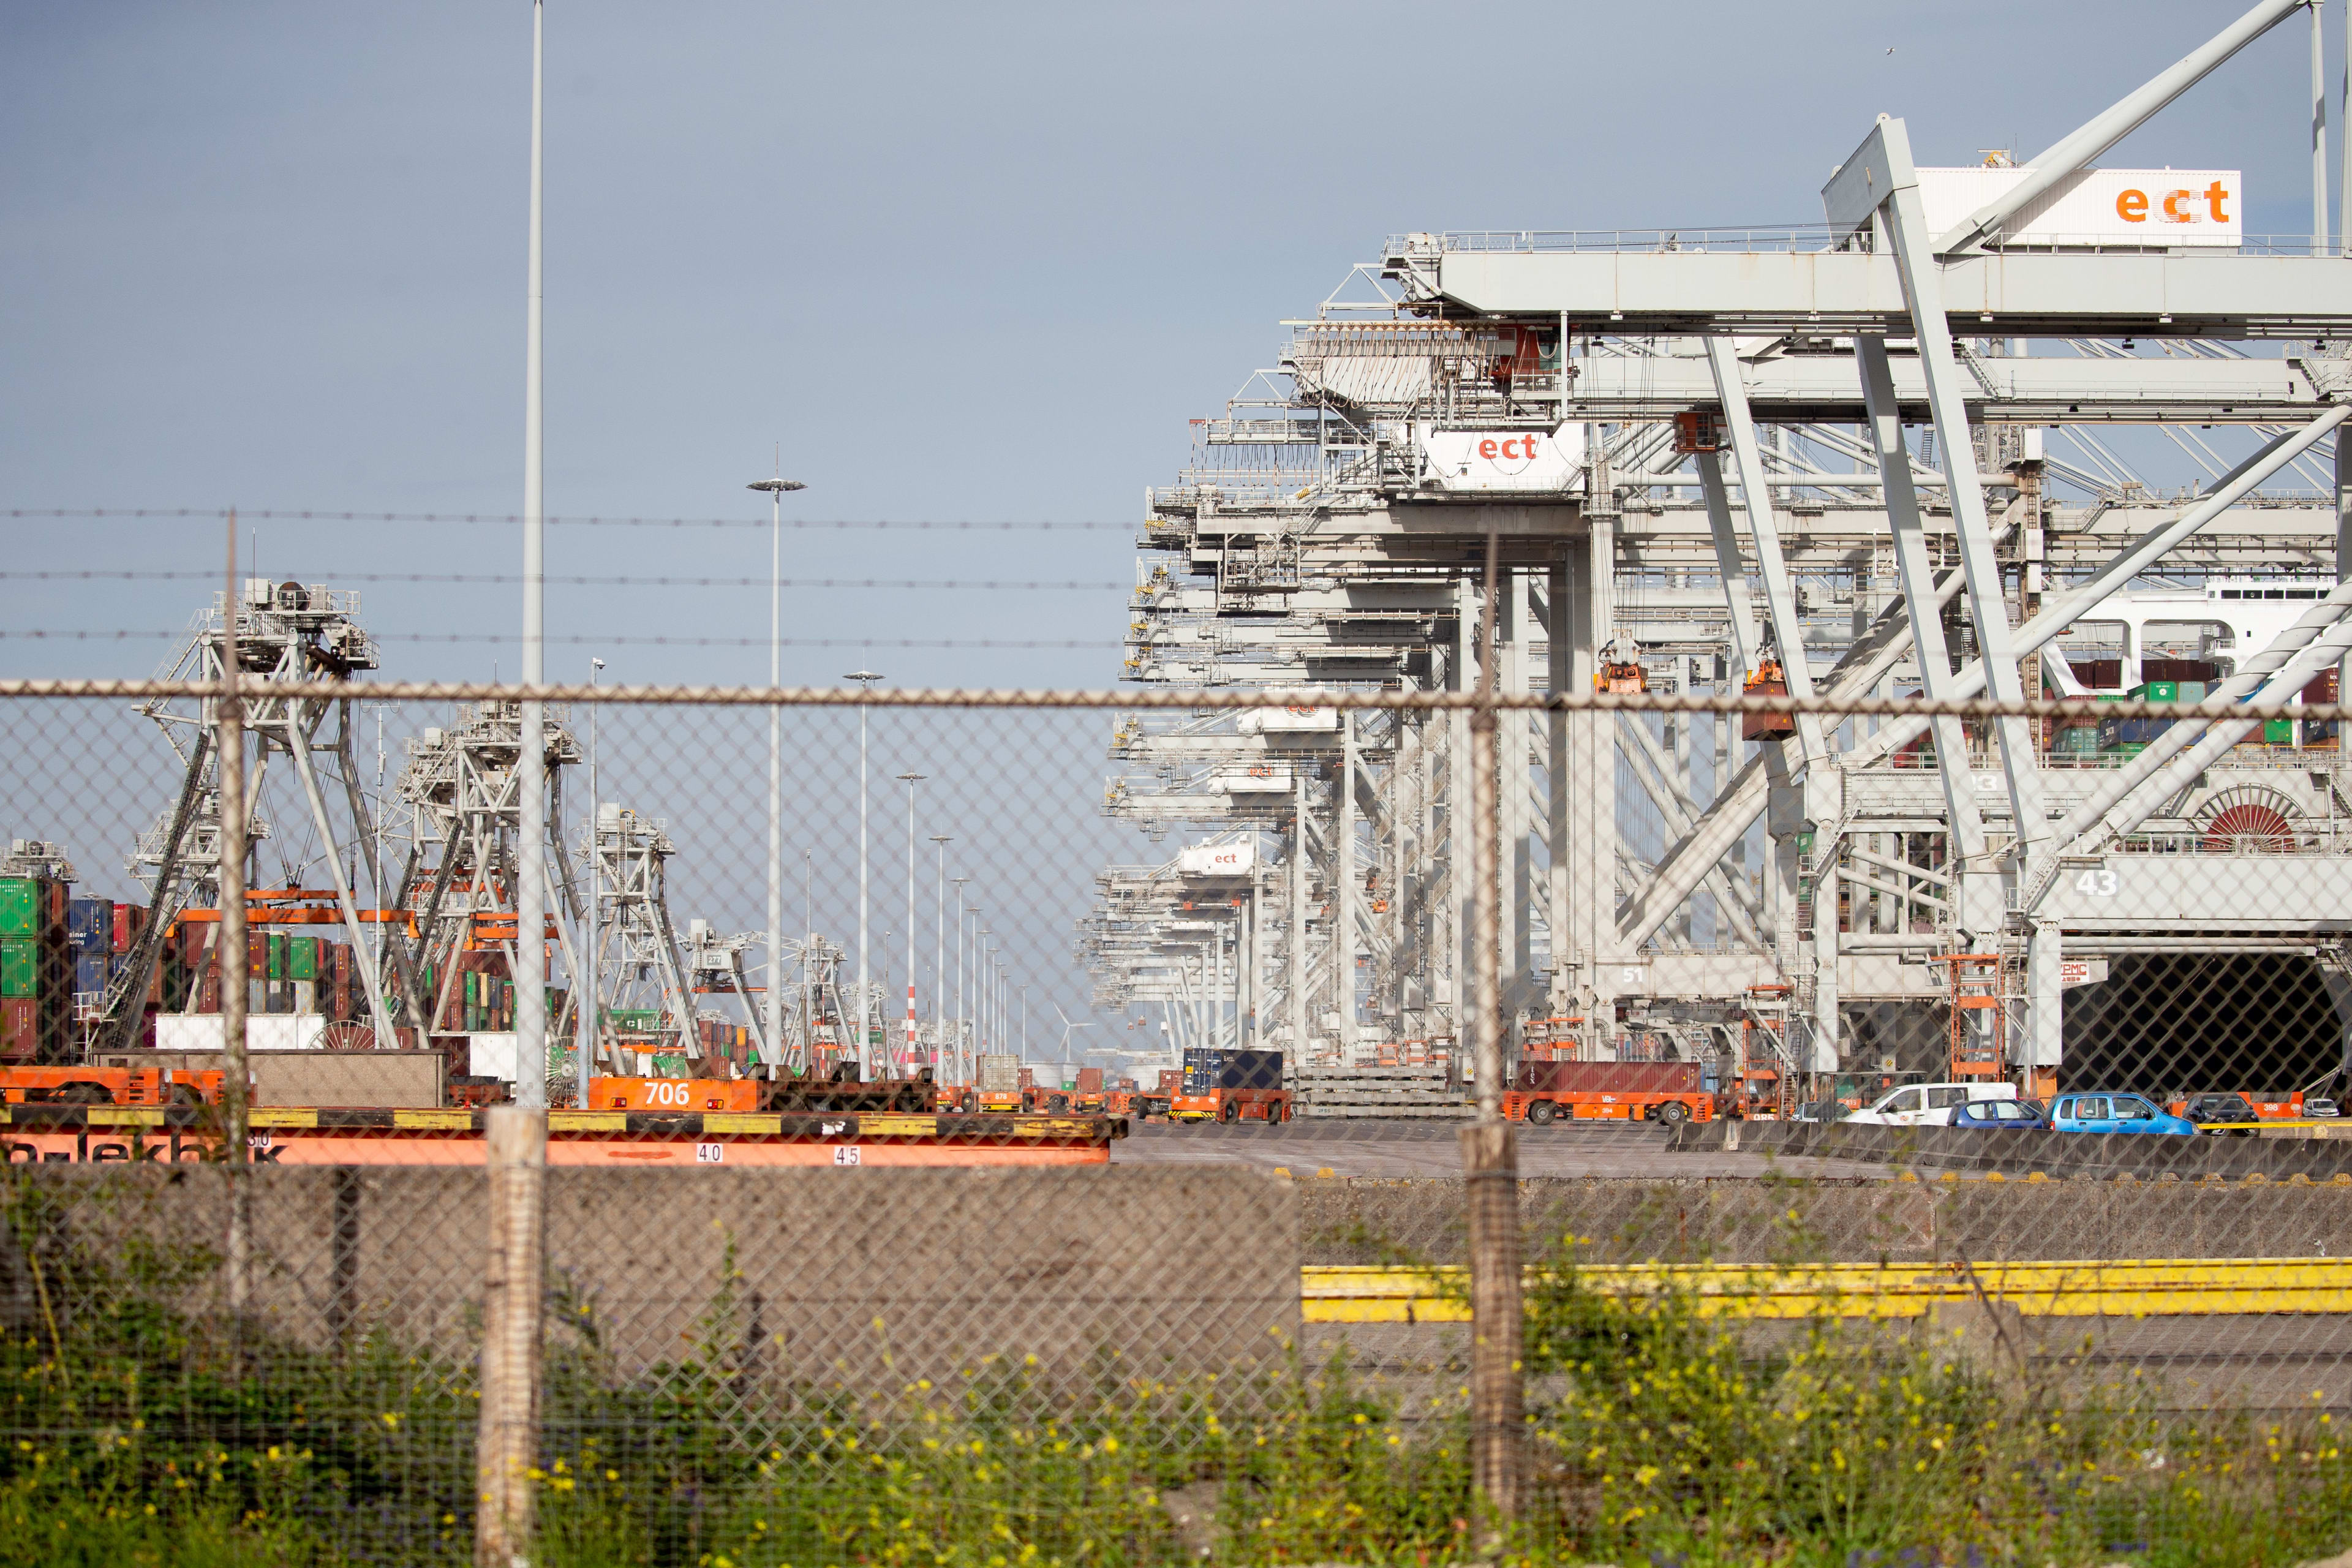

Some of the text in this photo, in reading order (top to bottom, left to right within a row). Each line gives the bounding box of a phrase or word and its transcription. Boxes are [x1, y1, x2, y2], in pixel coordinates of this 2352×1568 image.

[2116, 181, 2230, 223] ect
[1479, 434, 1536, 459] ect
[1250, 765, 1272, 776] ect
[1215, 854, 1237, 863] ect
[2076, 870, 2117, 896] 43
[1624, 967, 1643, 982] 51
[2061, 963, 2087, 975] PMC
[1359, 1029, 1373, 1038] 97
[645, 1082, 690, 1105] 706
[247, 1131, 269, 1147] 30
[699, 1145, 720, 1161] 40
[837, 1147, 858, 1164] 45
